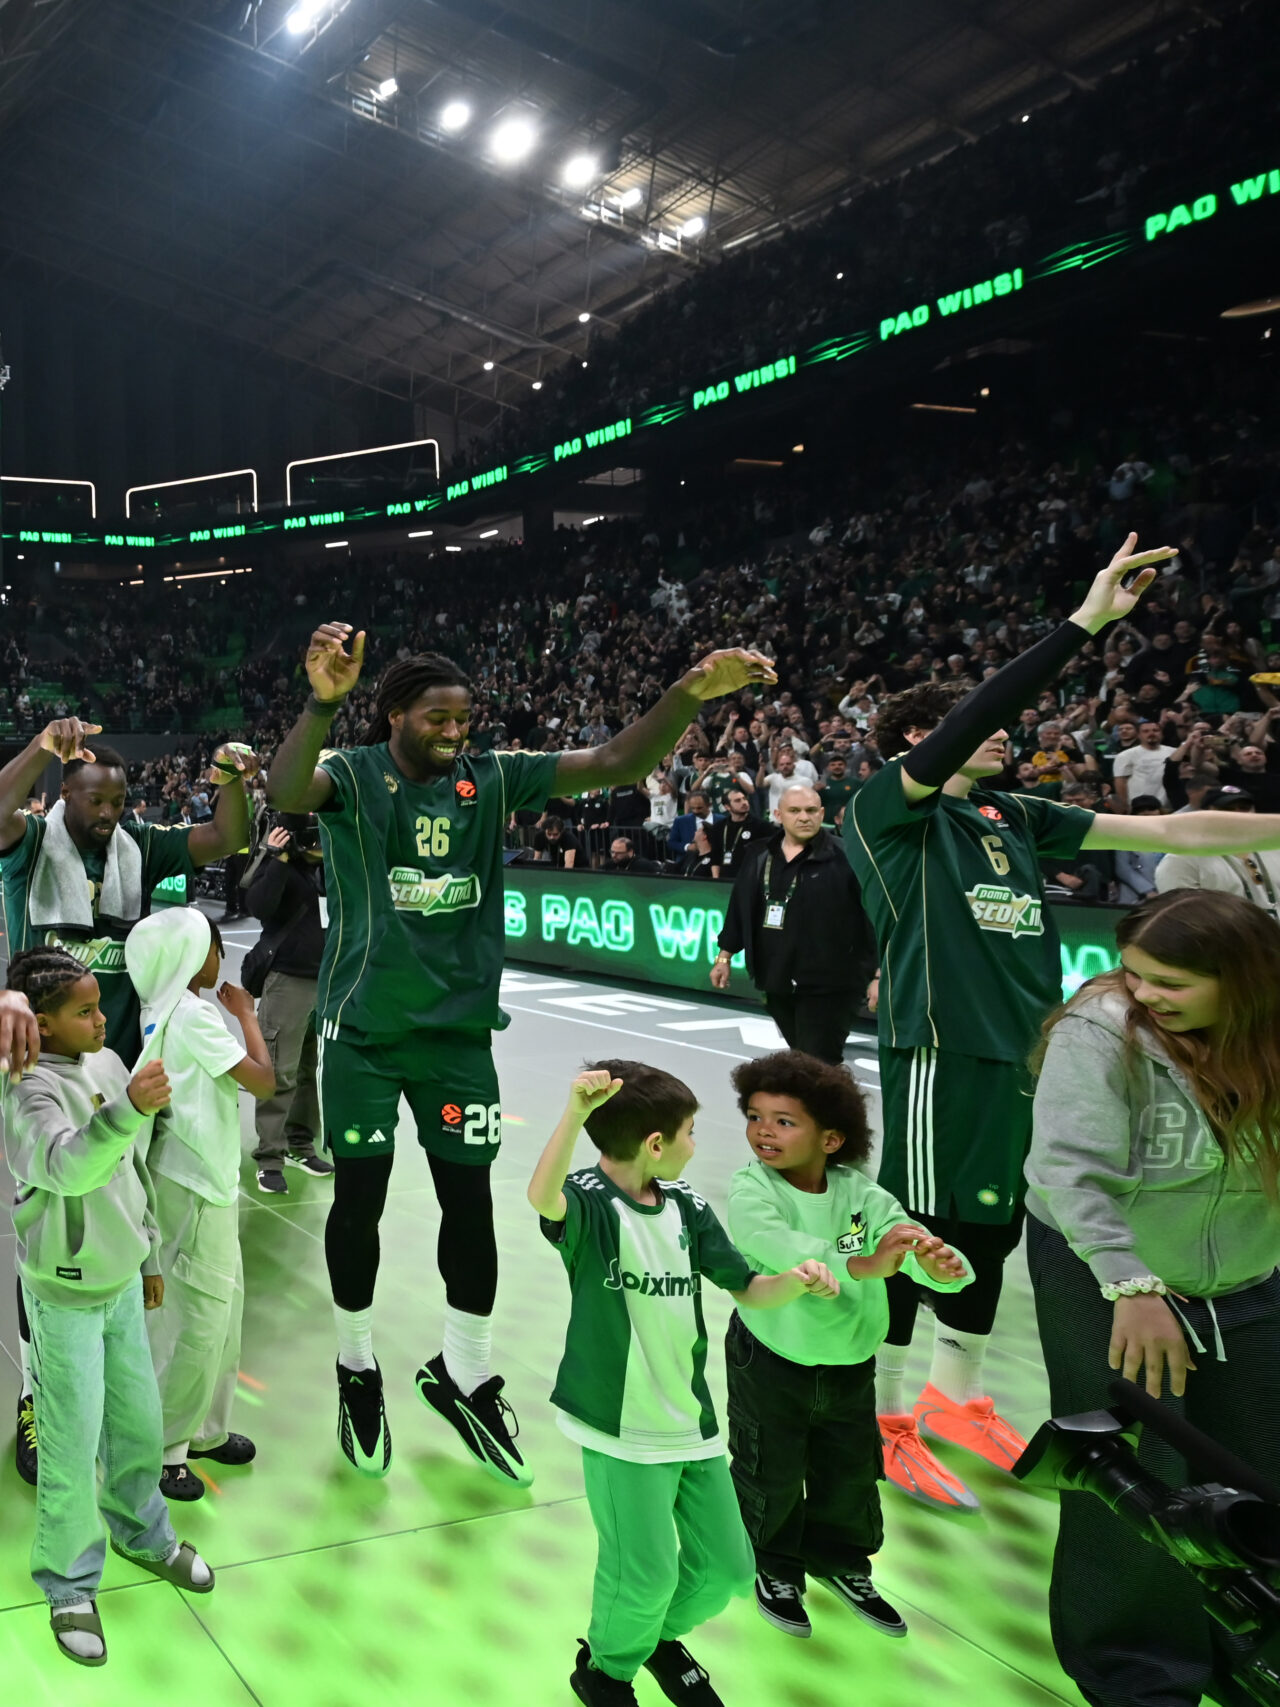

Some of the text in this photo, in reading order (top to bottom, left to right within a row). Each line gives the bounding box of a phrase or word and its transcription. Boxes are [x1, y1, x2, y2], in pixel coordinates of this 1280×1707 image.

[1146, 194, 1216, 240] PAO
[880, 305, 929, 340] PAO
[554, 438, 581, 461] PAO
[447, 481, 468, 500] PAO
[387, 503, 411, 516] PAO
[284, 517, 306, 529] PAO
[20, 531, 39, 541] PAO
[105, 535, 124, 545] PAO
[190, 530, 210, 542] PAO
[415, 816, 450, 857] 26
[981, 835, 1010, 875] 6
[978, 888, 1009, 901] pame
[542, 894, 634, 951] PAO
[464, 1103, 500, 1145] 26
[1135, 1102, 1257, 1170] GA
